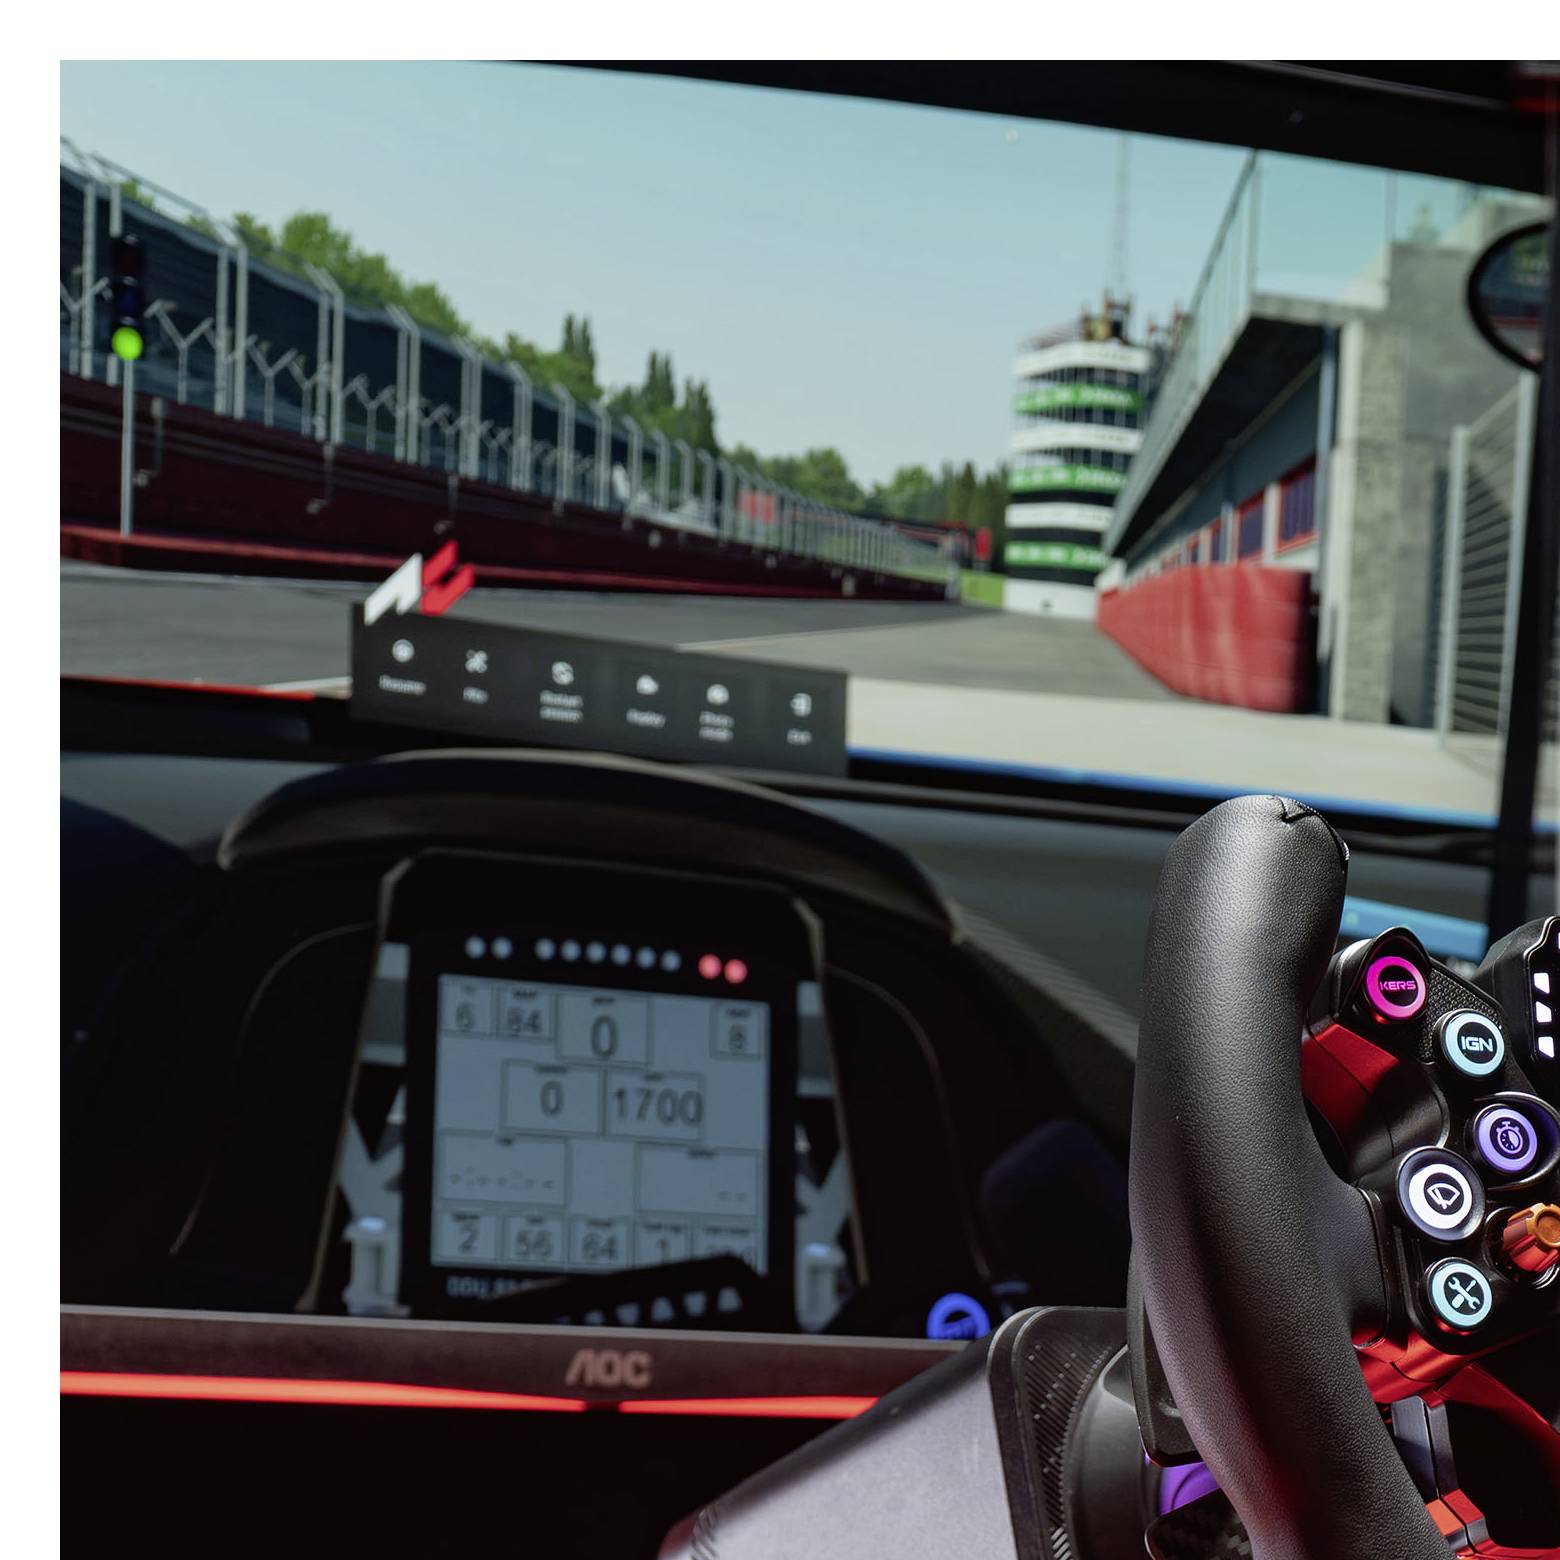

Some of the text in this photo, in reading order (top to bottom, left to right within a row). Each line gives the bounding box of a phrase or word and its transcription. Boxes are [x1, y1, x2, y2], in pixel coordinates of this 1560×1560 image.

[1380, 981, 1417, 991] KERS
[590, 1015, 620, 1061] 0
[1461, 1035, 1494, 1052] IGN
[540, 1080, 565, 1117] 0
[613, 1086, 704, 1127] 1700
[564, 1348, 653, 1389] AOC
